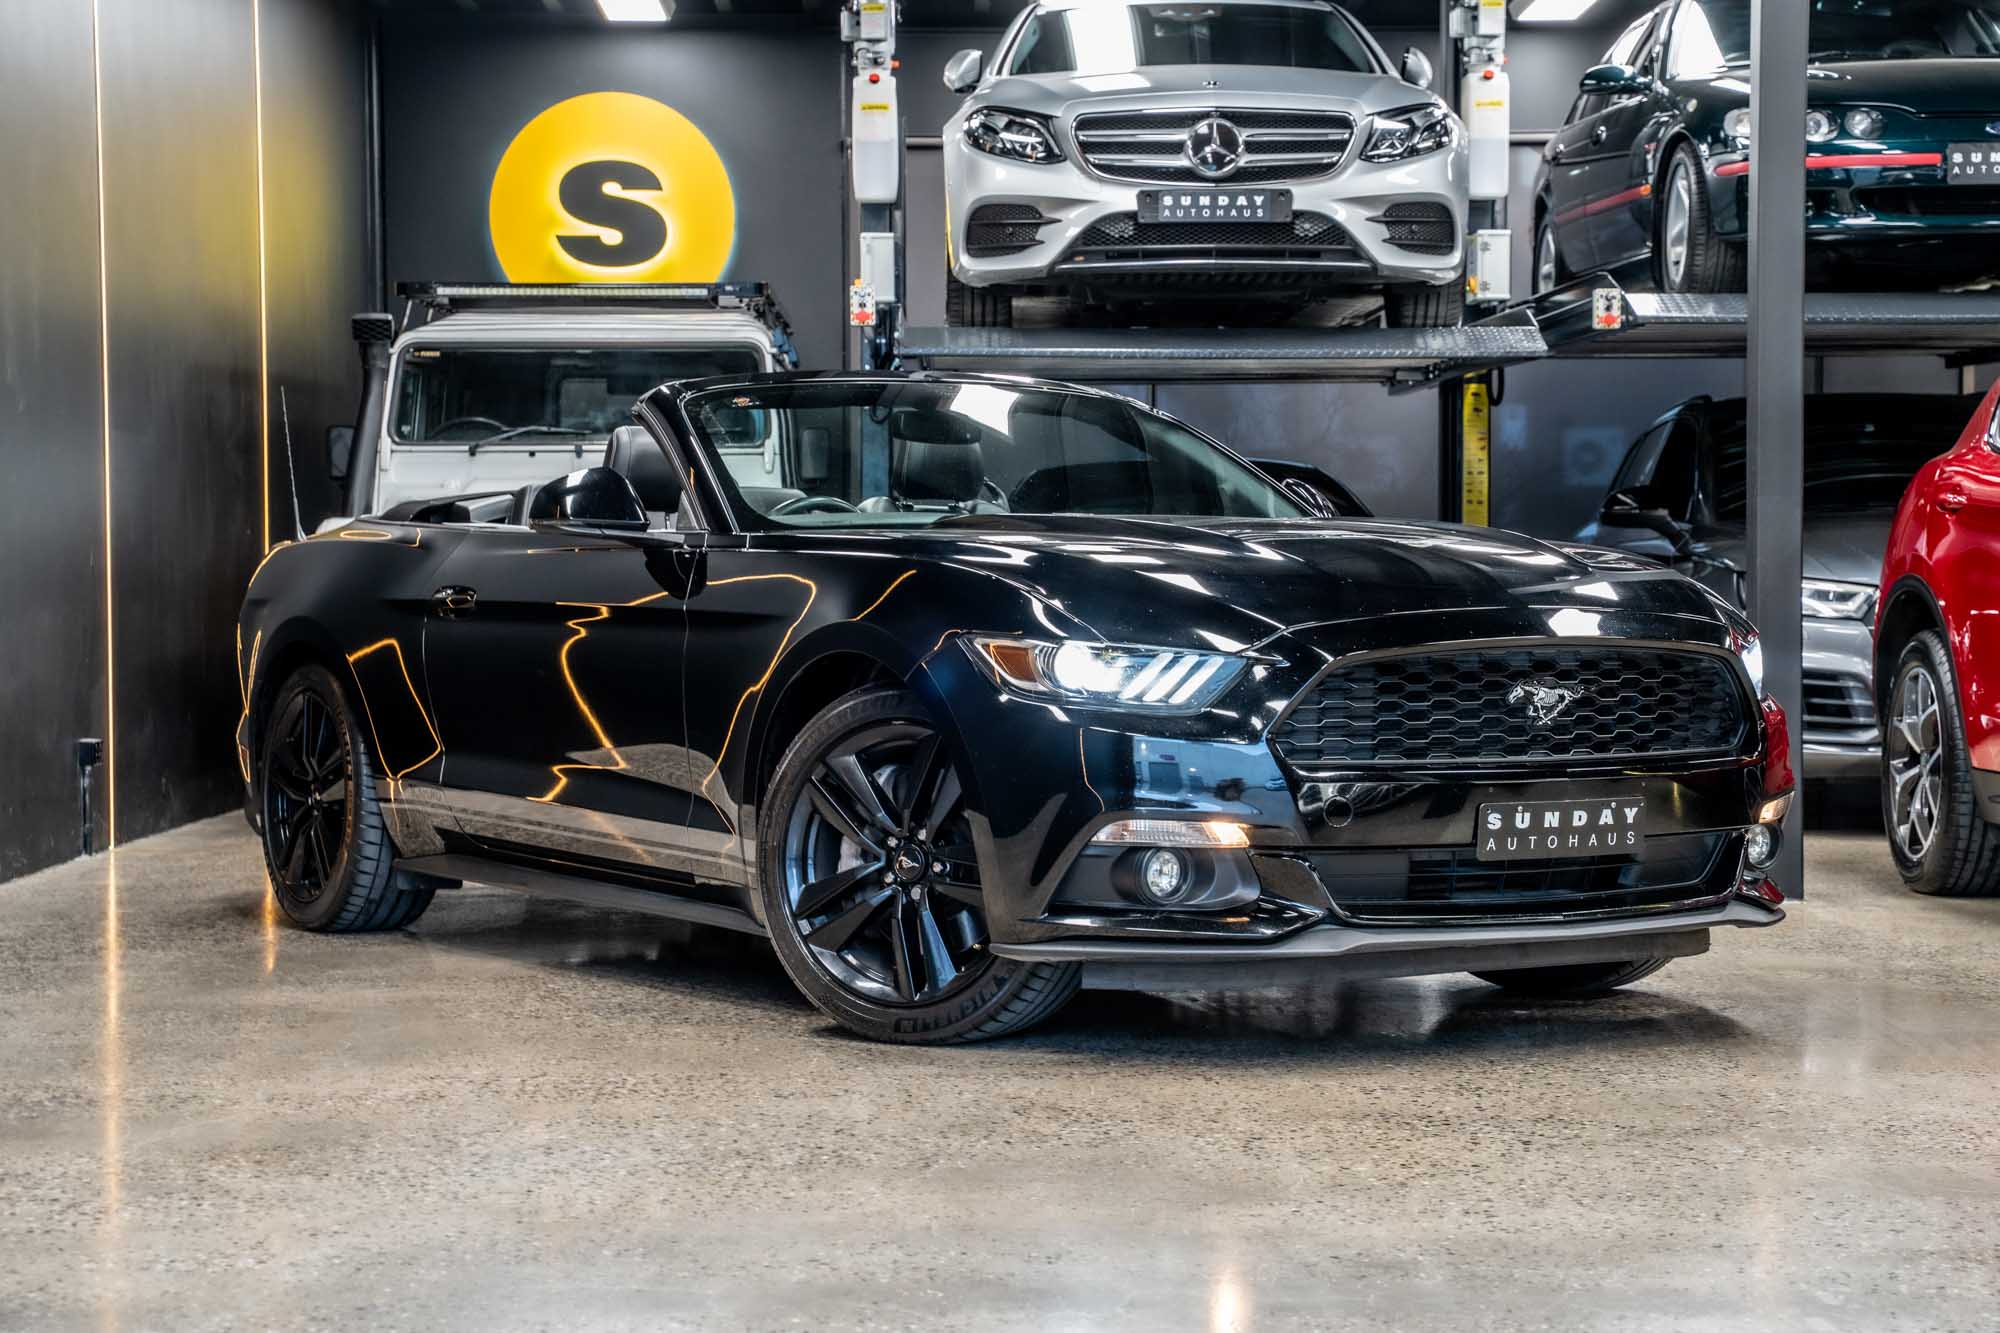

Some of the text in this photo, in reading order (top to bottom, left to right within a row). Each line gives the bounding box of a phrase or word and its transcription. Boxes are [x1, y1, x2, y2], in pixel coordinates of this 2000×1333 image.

[1162, 195, 1265, 206] SUNDAY
[556, 160, 667, 267] S
[1162, 208, 1265, 217] AUTOHAUS
[1487, 807, 1639, 830] SUNDAY
[1486, 831, 1636, 851] AUTOHAUS
